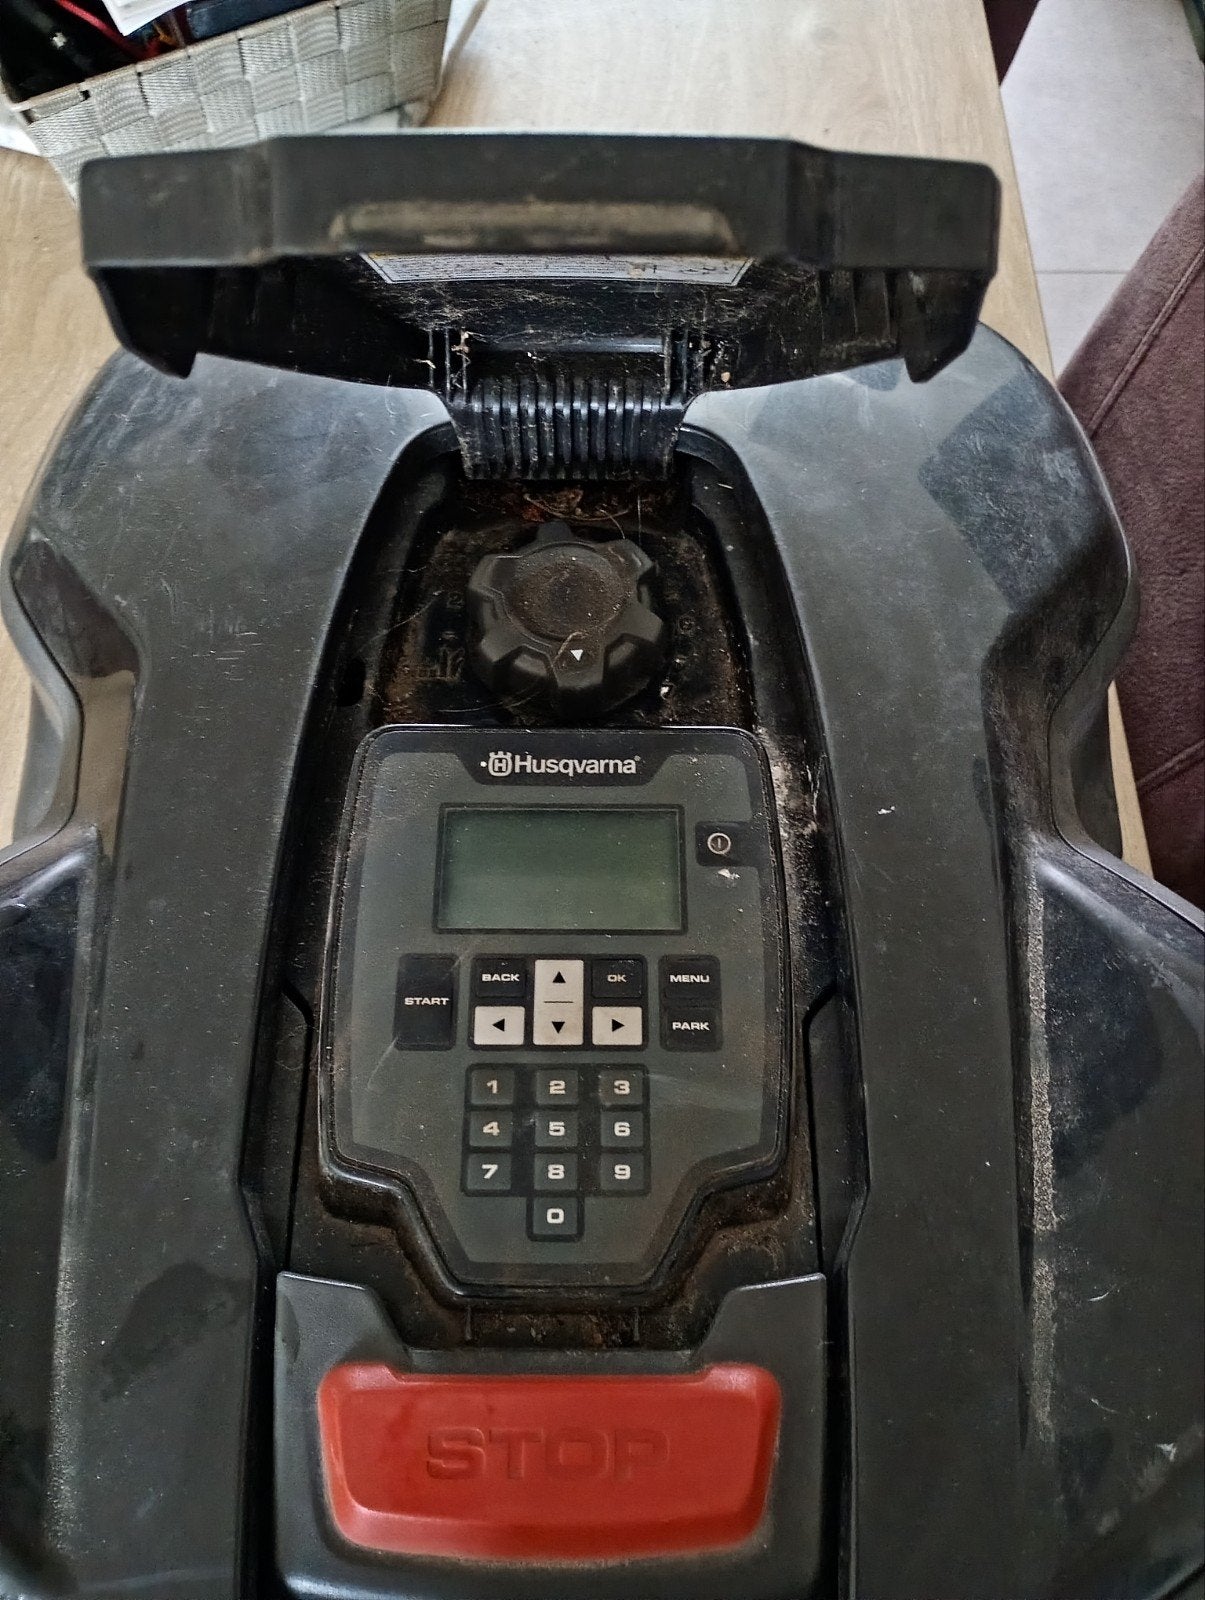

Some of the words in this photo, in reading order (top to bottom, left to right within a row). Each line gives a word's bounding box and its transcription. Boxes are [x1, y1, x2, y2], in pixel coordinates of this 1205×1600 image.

[514, 753, 637, 777] Husqvarna
[481, 972, 520, 982] BACK
[606, 973, 627, 983] OK
[669, 974, 711, 984] MENU
[403, 996, 450, 1006] START
[671, 1021, 711, 1032] PARK
[486, 1080, 499, 1094] 1
[549, 1080, 566, 1094] 2
[613, 1080, 630, 1094] 3
[482, 1122, 501, 1136] 4
[548, 1122, 566, 1136] 5
[614, 1122, 631, 1136] 6
[481, 1165, 499, 1180] 7
[547, 1164, 565, 1180] 8
[613, 1164, 631, 1180] 9
[546, 1208, 565, 1224] 0
[425, 1426, 670, 1481] STOP
